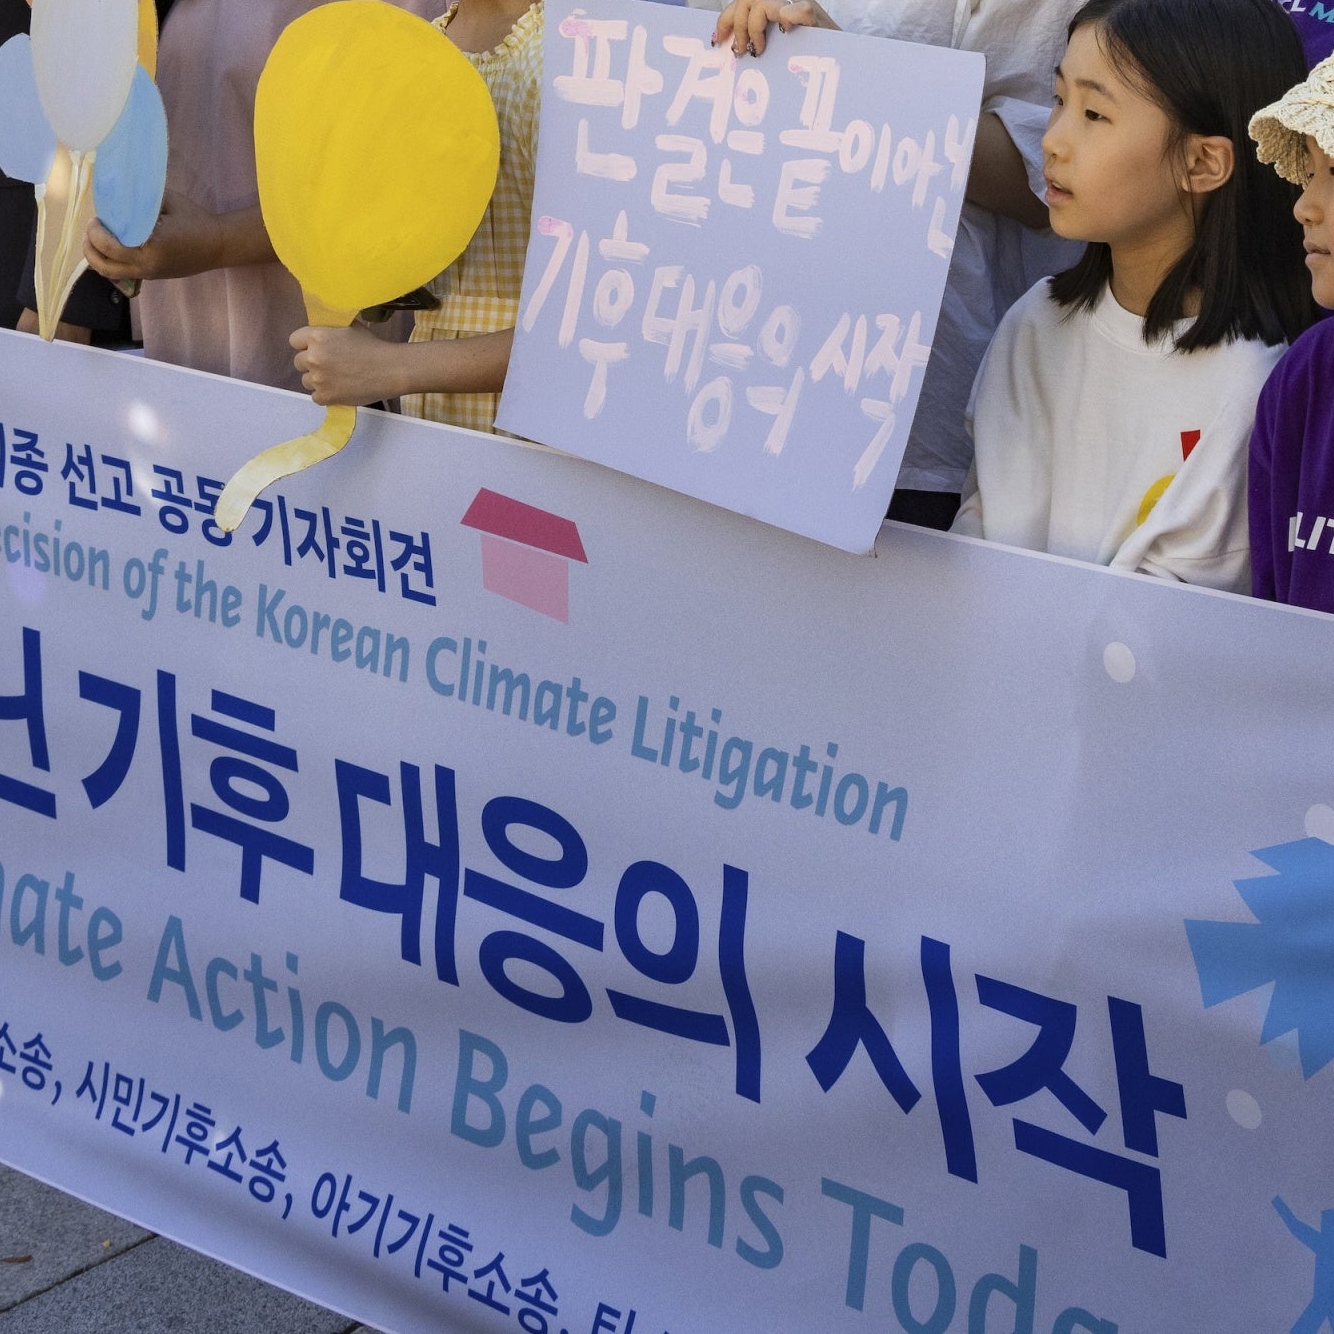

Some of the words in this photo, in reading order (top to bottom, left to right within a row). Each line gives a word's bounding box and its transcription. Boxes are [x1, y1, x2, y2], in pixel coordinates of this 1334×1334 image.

[552, 9, 770, 228] 판결은
[60, 441, 141, 516] 선고
[151, 463, 233, 547] 공동
[251, 495, 437, 607] 기자회견
[810, 311, 931, 491] 시작
[123, 548, 168, 621] of
[174, 559, 241, 628] the
[256, 583, 410, 683] Korean
[425, 635, 617, 745] Climate
[630, 694, 909, 842] Litigation
[78, 669, 314, 904] 기후
[335, 759, 760, 1103] 대응의
[805, 929, 1187, 1259] 시작
[147, 914, 417, 1115] Action
[450, 1028, 784, 1270] Begins
[76, 1060, 292, 1219] 시민기후소송,
[310, 1171, 569, 1334] 아기기후소송
